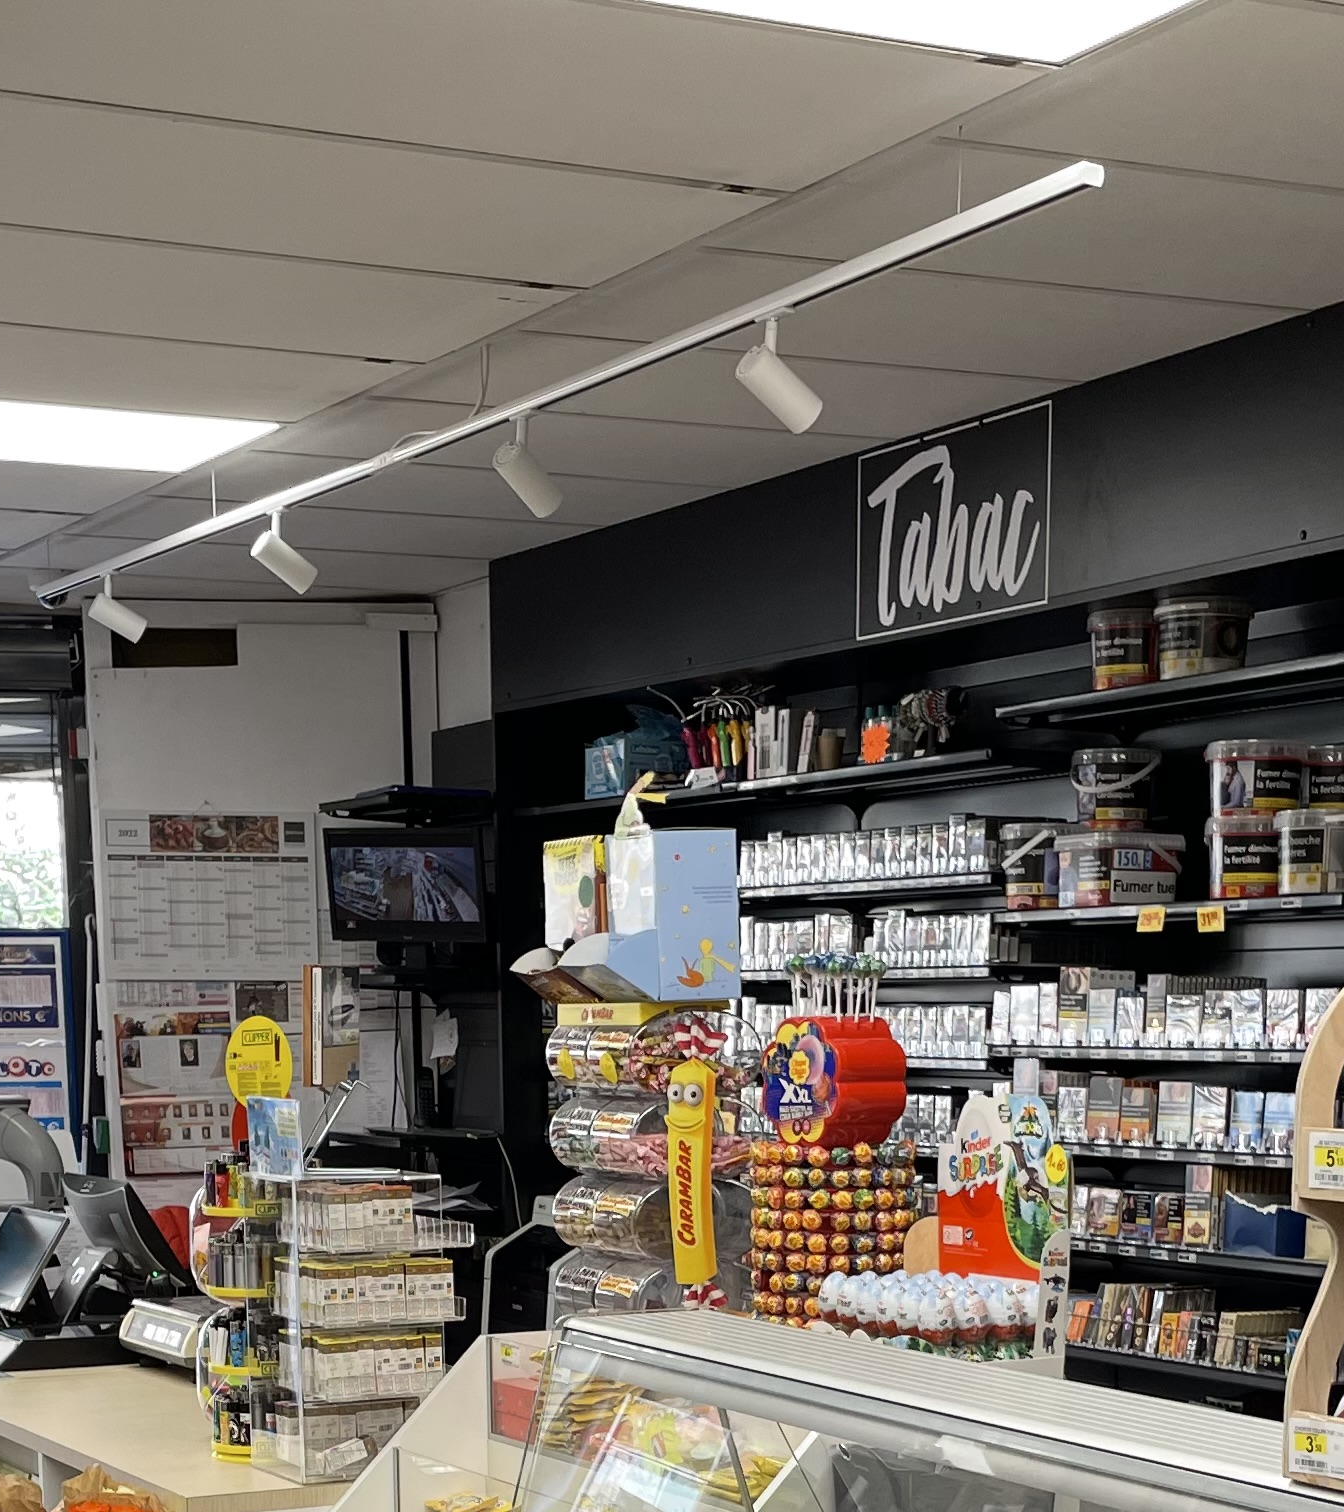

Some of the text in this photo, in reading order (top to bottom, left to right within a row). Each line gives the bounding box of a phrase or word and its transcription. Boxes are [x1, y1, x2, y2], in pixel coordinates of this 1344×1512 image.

[867, 444, 1040, 627] Tabac
[1113, 879, 1175, 894] Fumer tue
[243, 1031, 271, 1043] CLIPPER
